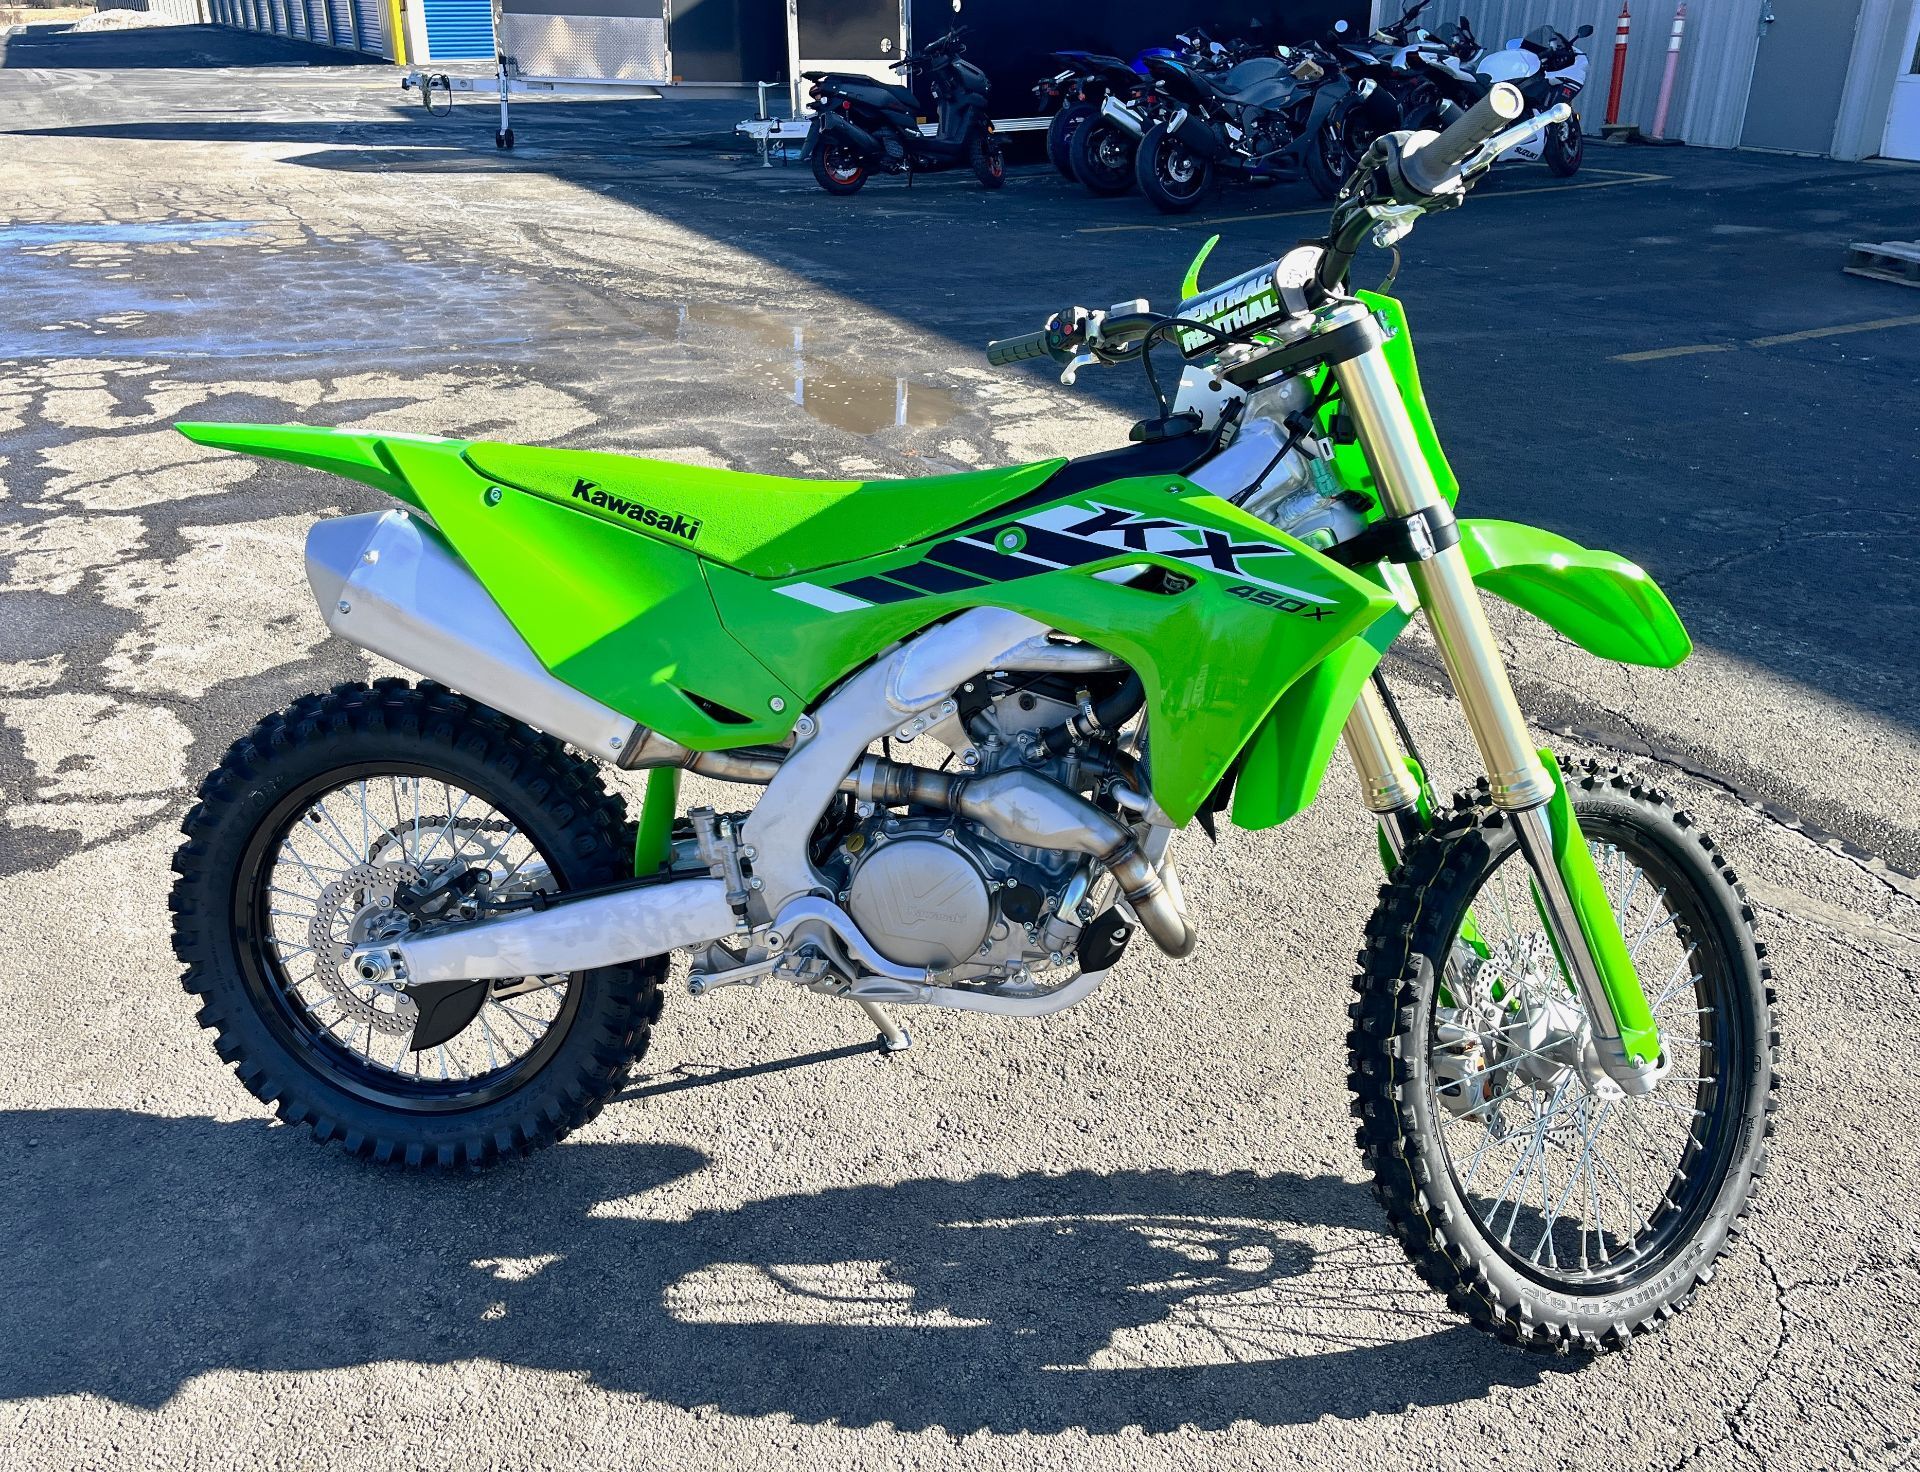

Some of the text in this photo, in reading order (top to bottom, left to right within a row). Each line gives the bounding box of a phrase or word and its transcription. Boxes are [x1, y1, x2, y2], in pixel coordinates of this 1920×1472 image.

[1514, 146, 1539, 160] SUZUKI
[571, 478, 701, 541] Kawasaki
[1062, 504, 1290, 577] KX
